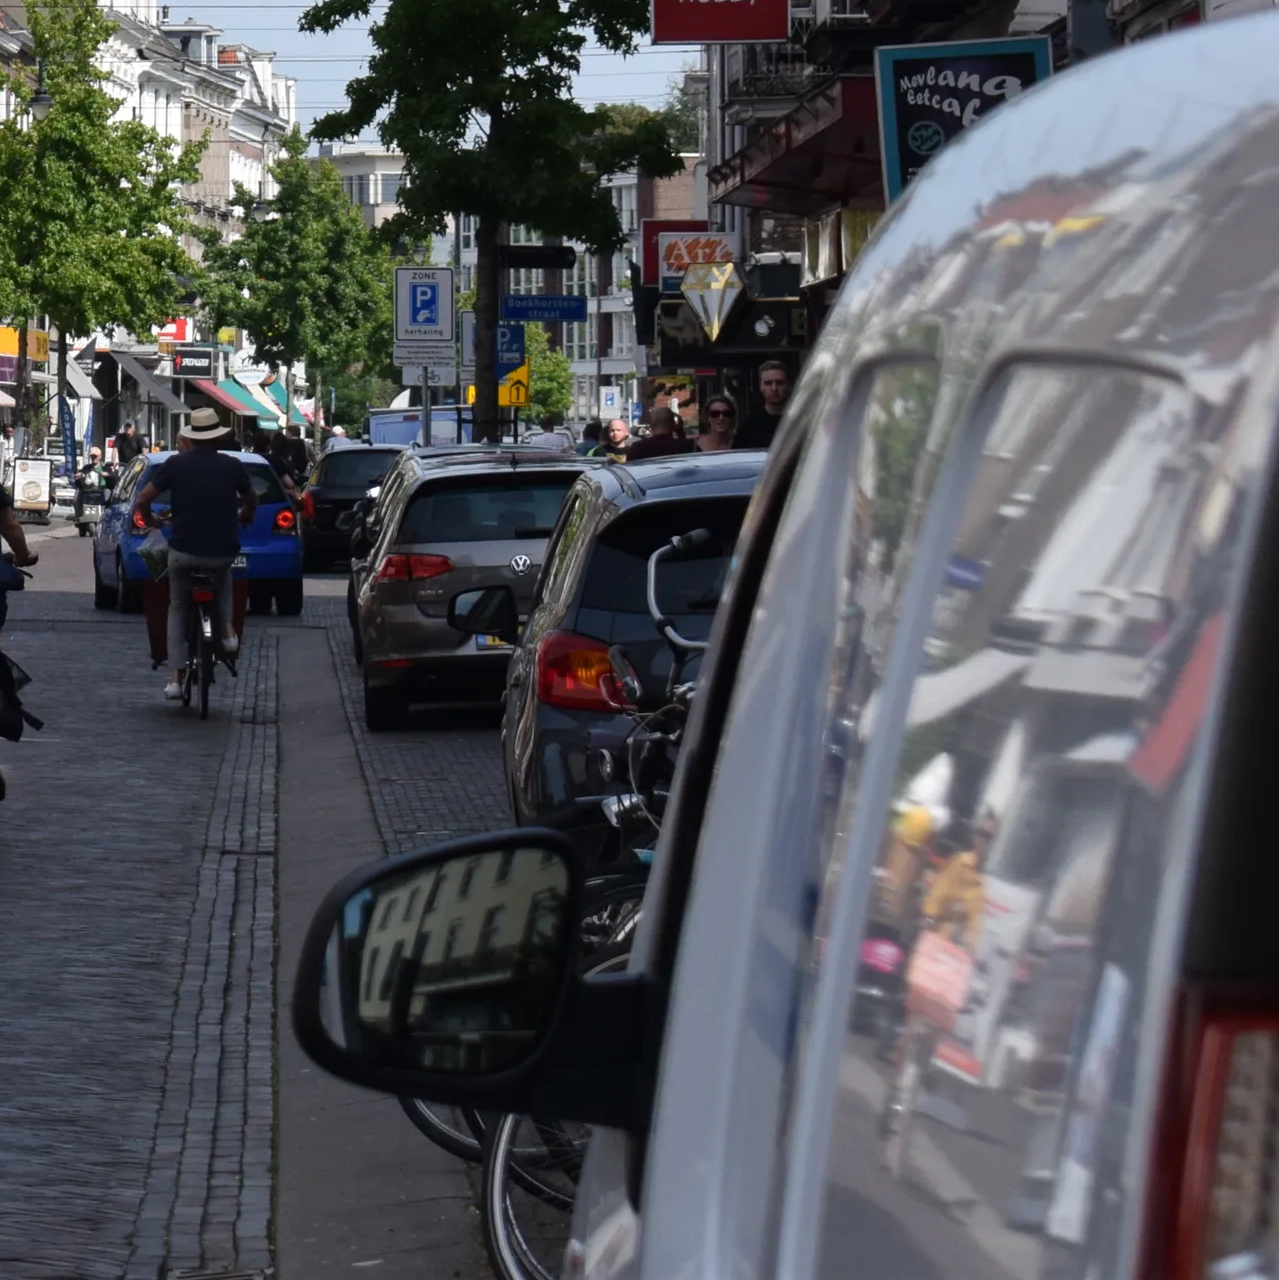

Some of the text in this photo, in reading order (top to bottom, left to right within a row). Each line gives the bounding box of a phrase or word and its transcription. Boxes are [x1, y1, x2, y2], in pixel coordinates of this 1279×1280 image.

[906, 88, 982, 128] Eetcaf
[411, 272, 437, 280] ZONE
[416, 286, 432, 308] P
[508, 298, 580, 308] Boekhorsten-
[528, 309, 560, 318] straat
[405, 328, 443, 336] herhaling
